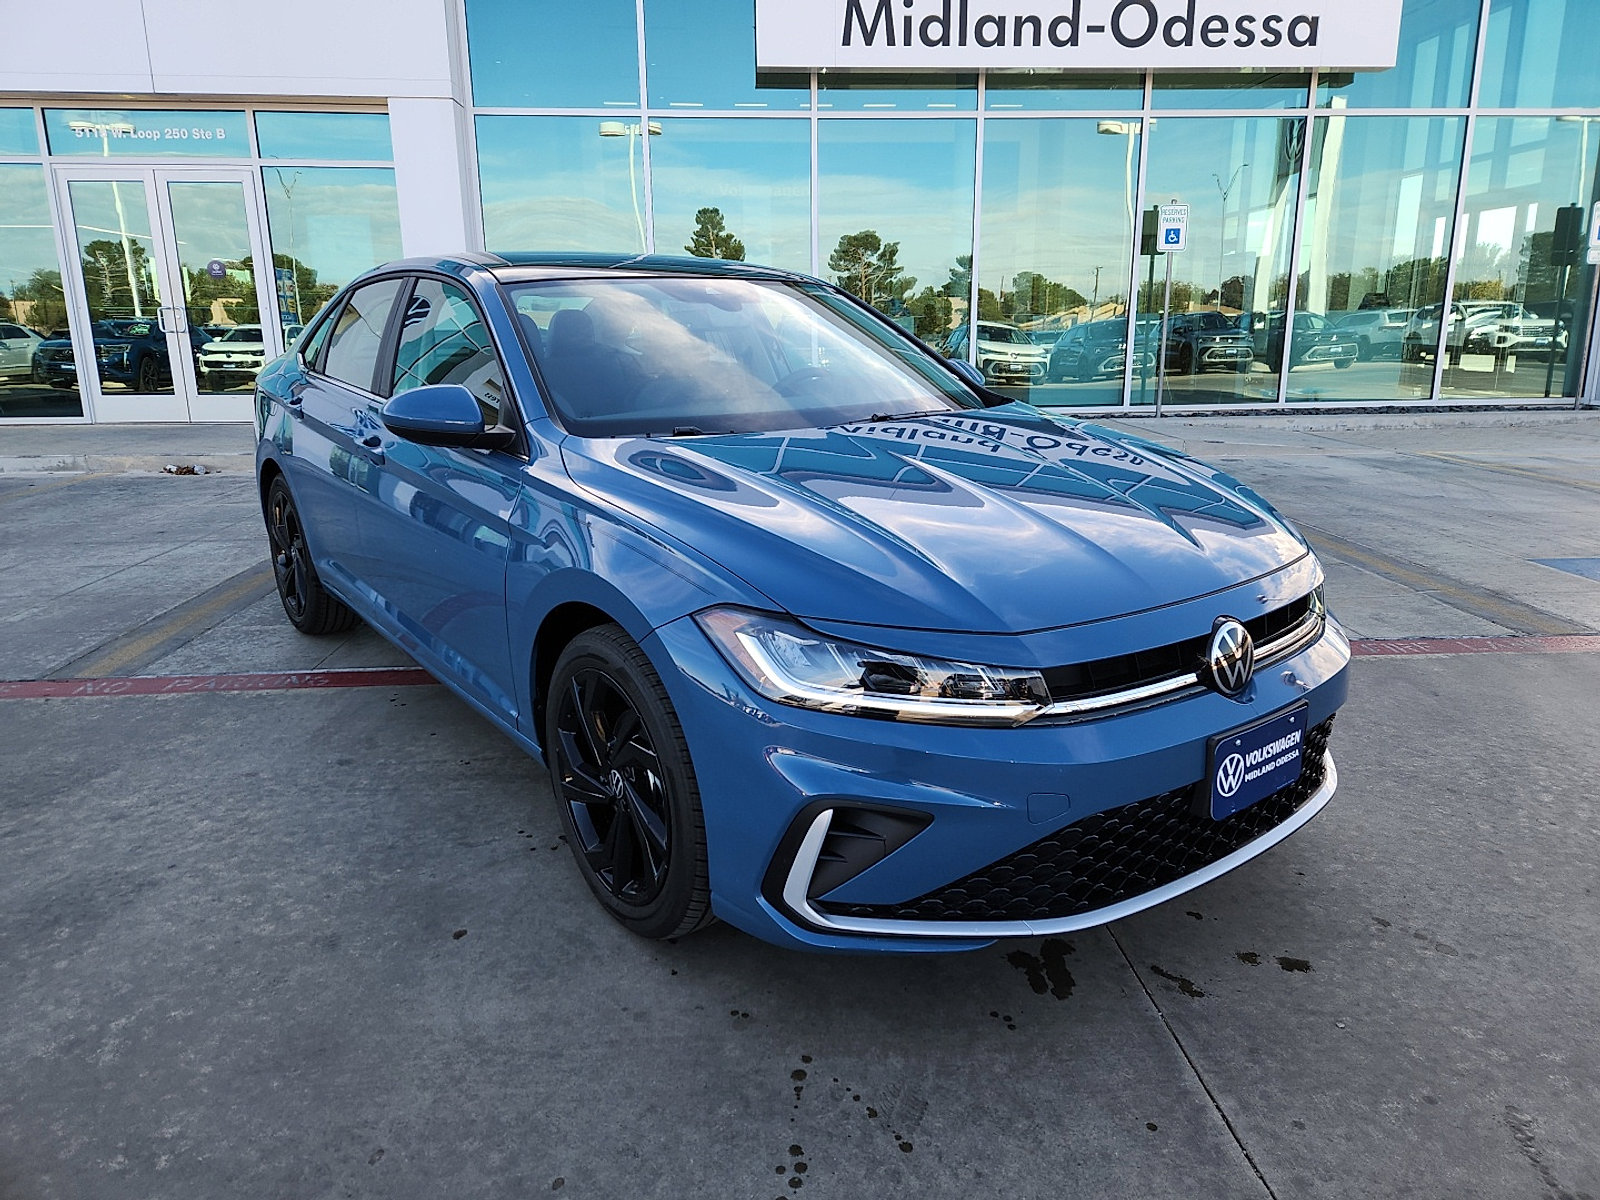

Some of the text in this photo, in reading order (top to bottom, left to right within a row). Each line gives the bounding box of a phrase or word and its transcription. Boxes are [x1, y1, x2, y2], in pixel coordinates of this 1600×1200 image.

[841, 0, 1320, 49] Midland-Odessa
[131, 127, 160, 141] Loop
[164, 128, 188, 139] 250
[192, 128, 212, 139] Ste
[216, 128, 226, 139] B
[1244, 748, 1300, 783] MIDLAND ODESSA
[1245, 729, 1302, 768] VOLKSWAGEN
